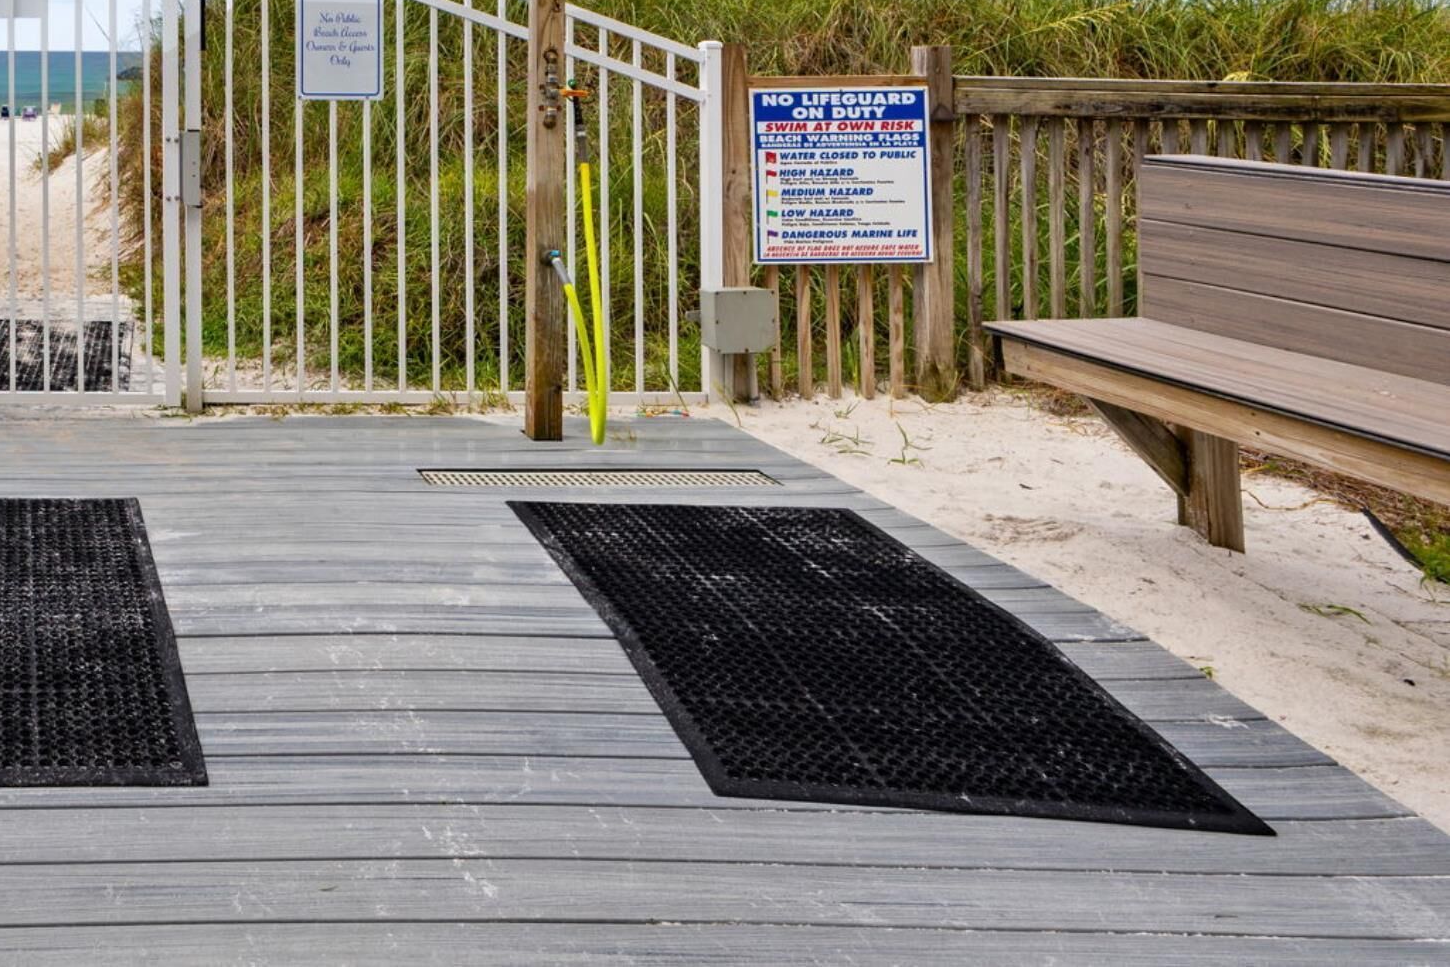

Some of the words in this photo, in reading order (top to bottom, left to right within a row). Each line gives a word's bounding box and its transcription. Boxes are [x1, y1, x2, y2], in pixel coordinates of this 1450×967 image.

[319, 11, 334, 23] No
[335, 12, 361, 23] Public
[314, 26, 339, 37] Beach
[340, 26, 368, 37] Access
[306, 40, 337, 52] Owners
[338, 41, 347, 51] &
[349, 40, 375, 54] Guests
[330, 54, 351, 68] Only
[762, 93, 794, 107] NO
[802, 92, 917, 106] LIFEGUARD
[791, 106, 825, 120] ON
[831, 106, 887, 119] DUTY
[765, 122, 808, 133] SWIM
[813, 122, 832, 132] AT
[837, 121, 875, 132] OWN
[880, 120, 915, 131] RISK
[759, 135, 802, 143] BEACH
[806, 134, 873, 142] WARNING
[878, 133, 920, 141] FLAGS
[779, 152, 816, 160] WATER
[819, 151, 859, 160] CLOSED
[863, 151, 876, 159] TO
[880, 150, 917, 159] PUBLIC
[779, 169, 807, 177] HIGH
[809, 168, 855, 177] HAZARD
[781, 187, 825, 196] MEDIUM
[829, 187, 874, 195] HAZARD
[781, 209, 806, 217] LOW
[809, 208, 855, 217] HAZARD
[781, 230, 848, 239] DANGEROUS
[850, 230, 894, 238] MARINE
[897, 229, 918, 238] LIFE
